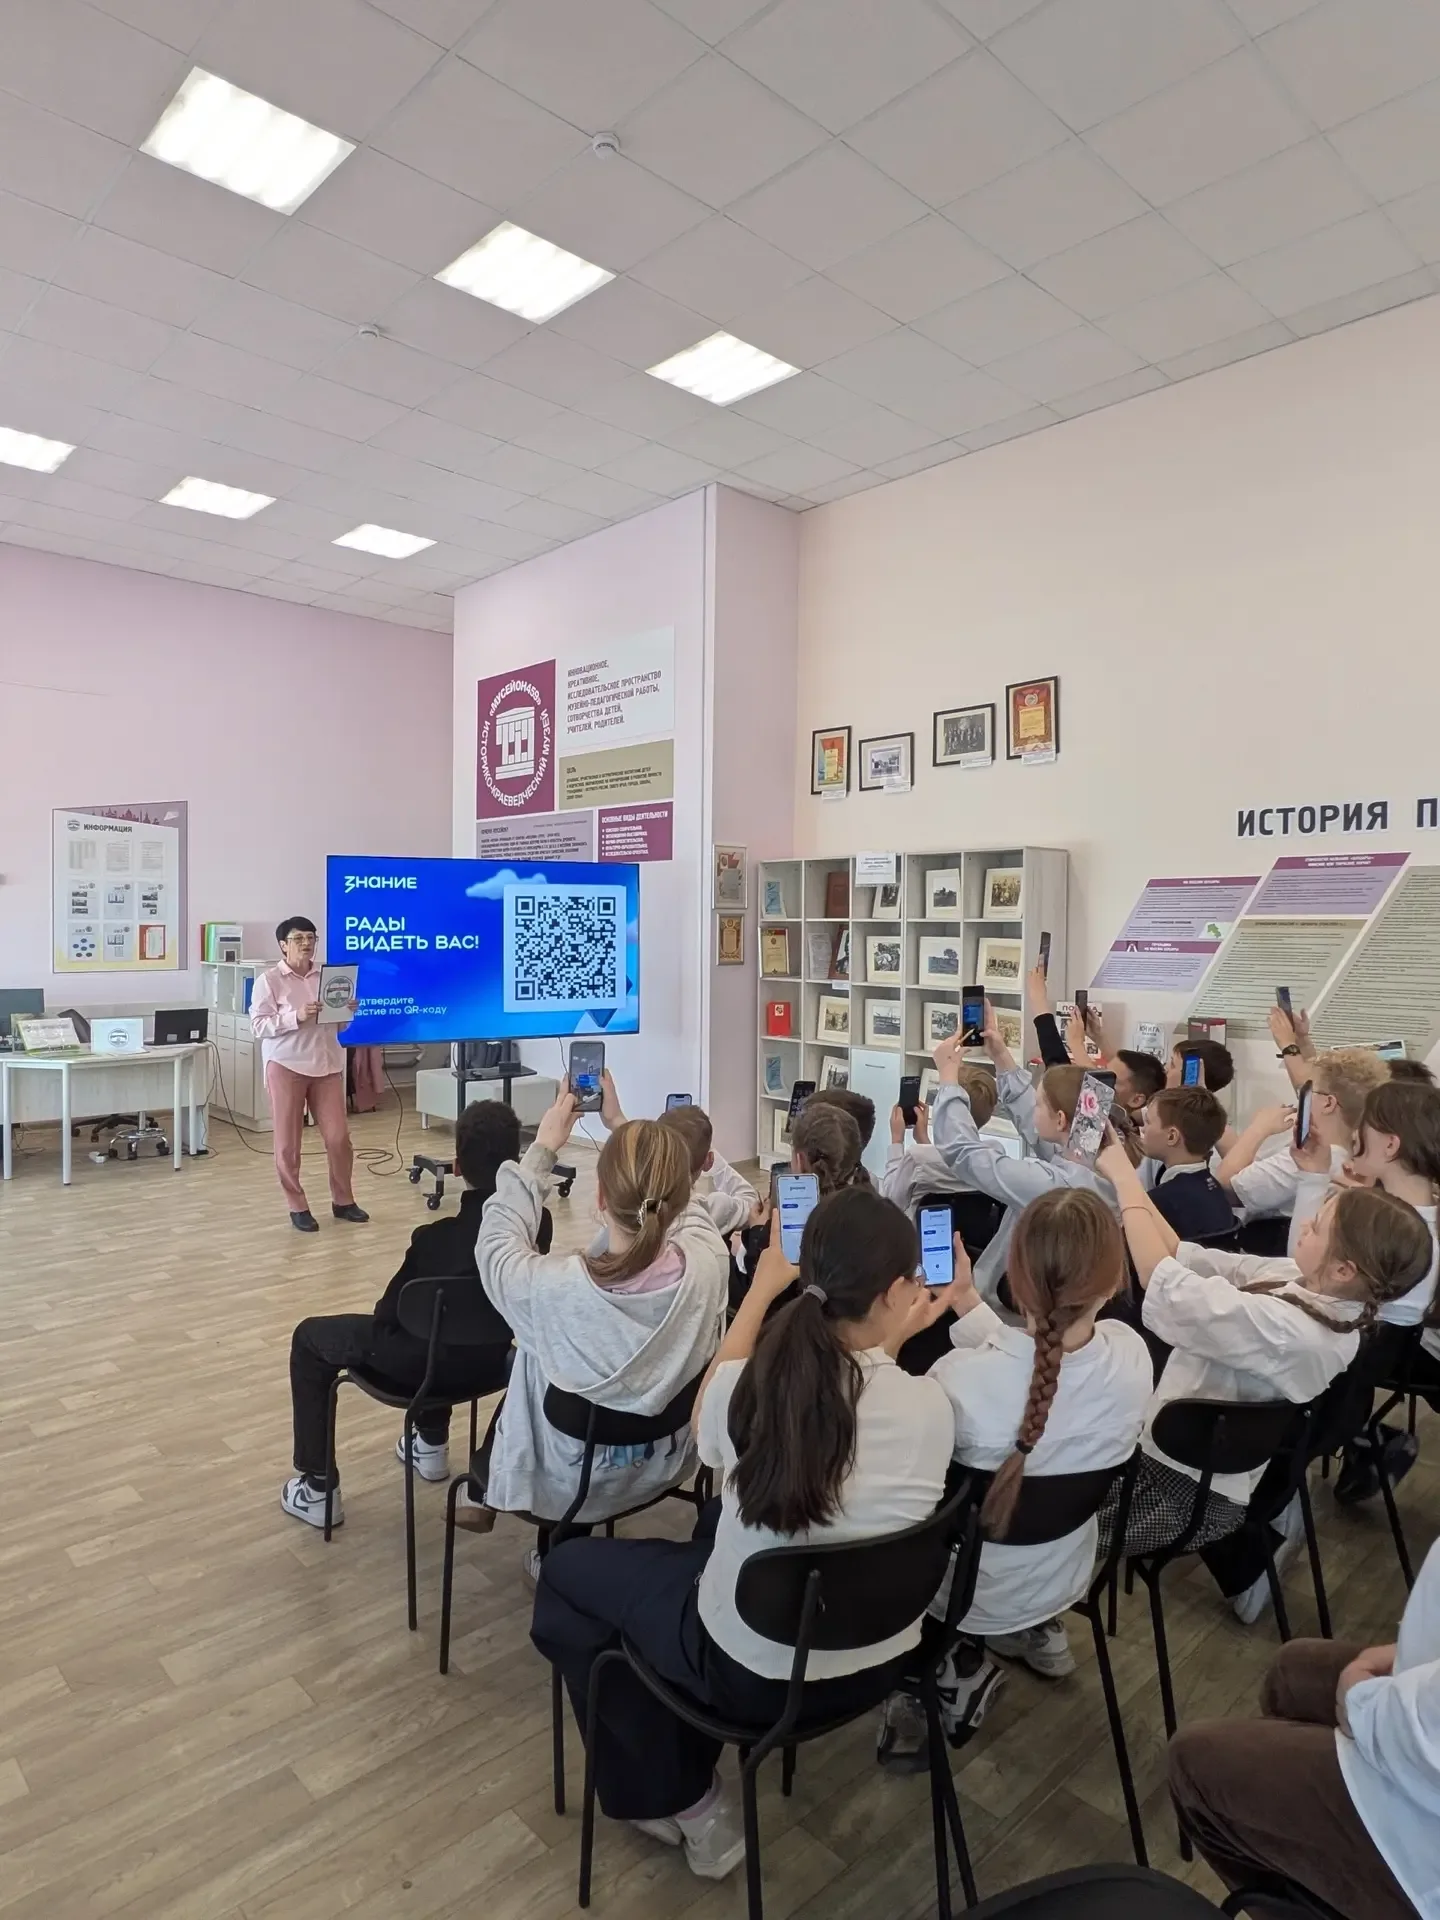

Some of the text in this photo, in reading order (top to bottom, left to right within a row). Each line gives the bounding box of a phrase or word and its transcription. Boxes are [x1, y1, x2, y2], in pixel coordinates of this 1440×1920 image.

[567, 673, 600, 689] КРЕАТИВНОЕ,
[567, 670, 662, 700] ИССЛЕДОВАТЕЛЬСКОЕ ПРОСТРАНСТВО
[567, 683, 660, 712] МУЗЕЙНО-ПЕДАГОГИЧЕСКОЙ РАБОТЫ,
[567, 702, 623, 723] СОТВОРЧЕСТВА ДЕТЕЙ,
[566, 721, 593, 735] УЧИТЕЛЕЙ,
[480, 720, 548, 807] ИСТОРИКО-КРАЕВЕДЧЕСКИЙ
[540, 708, 551, 755] МУЗЕЙ
[1237, 801, 1389, 837] ИСТОРИЯ
[83, 823, 133, 833] ИНФОРМАЦИЯ
[345, 916, 406, 933] РАДЫ
[345, 935, 480, 952] ВИДЕТЬ ВАС!
[358, 997, 415, 1007] дтвердите
[354, 1005, 448, 1017] астие по QR-коду
